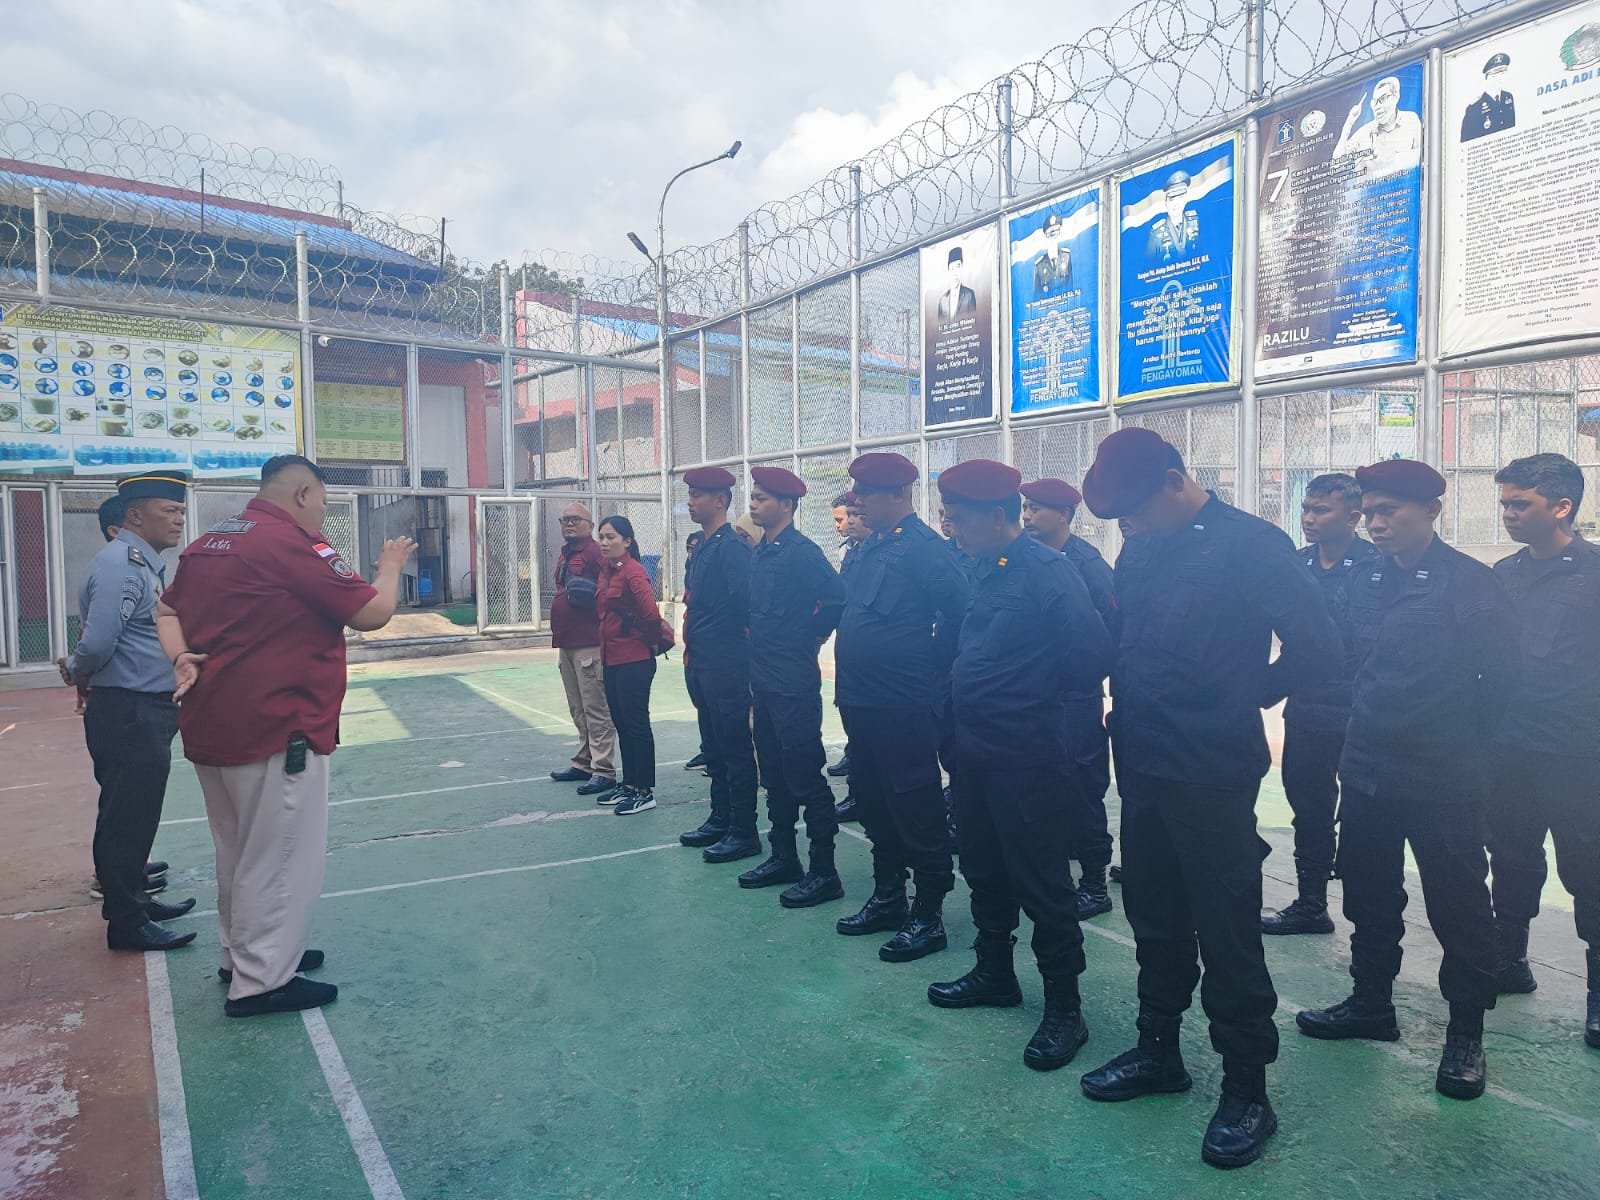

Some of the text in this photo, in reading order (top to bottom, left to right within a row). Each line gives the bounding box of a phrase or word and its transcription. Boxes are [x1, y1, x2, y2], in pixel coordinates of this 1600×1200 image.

[1536, 79, 1568, 96] DASA
[1572, 70, 1593, 85] ADI
[1291, 165, 1320, 177] Karakter
[1267, 167, 1289, 203] 7
[1291, 181, 1329, 197] Keagungan
[1172, 289, 1187, 300] saja
[1188, 282, 1218, 295] tidaklah
[1143, 296, 1202, 315] cukup, kita harus
[1206, 302, 1222, 312] saja
[1189, 315, 1202, 325] kita
[1202, 313, 1219, 325] juga
[1135, 335, 1154, 346] harus
[1263, 327, 1310, 347] RAZILU
[1141, 364, 1203, 384] PENGAYOMAN
